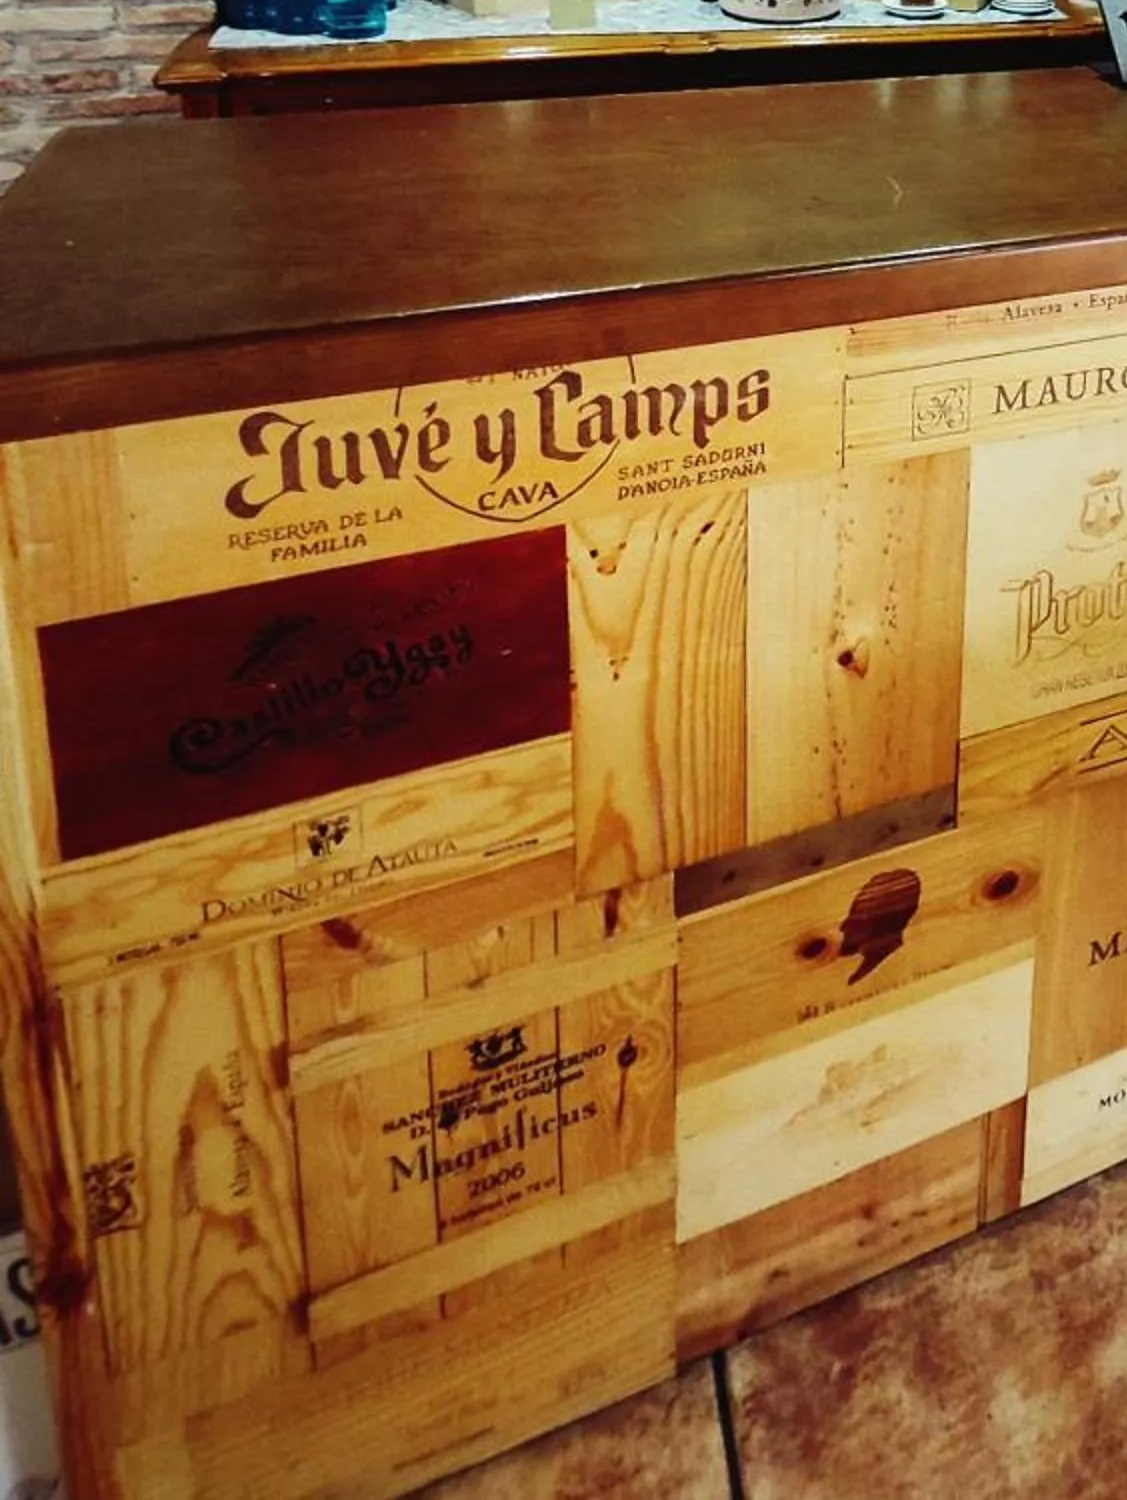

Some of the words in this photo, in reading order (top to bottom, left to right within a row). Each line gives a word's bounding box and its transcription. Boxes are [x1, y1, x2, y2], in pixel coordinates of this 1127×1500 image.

[1002, 299, 1064, 322] Alavesa
[225, 400, 453, 520] Juvé
[475, 415, 518, 482] y
[532, 365, 773, 465] Camps
[617, 454, 672, 482] SANT
[477, 479, 560, 512] CAVA
[227, 518, 330, 552] RESERVA
[338, 510, 369, 533] DE
[374, 504, 405, 527] LA
[270, 530, 369, 564] FAMILIA
[388, 1098, 600, 1194] Magnificus
[466, 1160, 527, 1198] 2006
